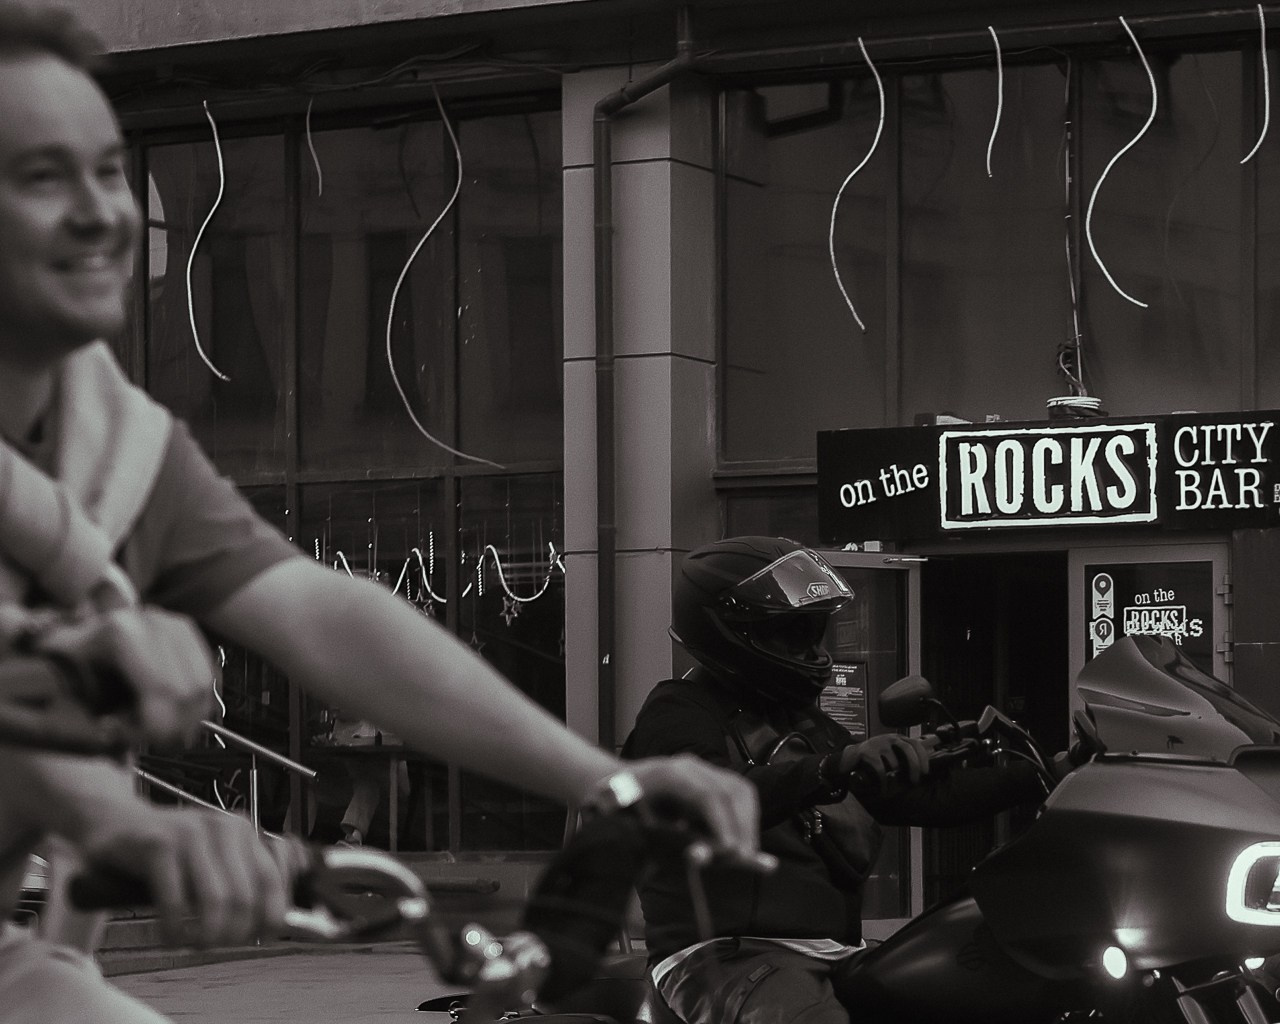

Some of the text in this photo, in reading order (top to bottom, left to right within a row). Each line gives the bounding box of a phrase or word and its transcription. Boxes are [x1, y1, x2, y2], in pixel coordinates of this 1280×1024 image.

[1174, 422, 1274, 467] CITY
[840, 434, 1137, 516] on the ROCKS
[1175, 467, 1264, 510] BAR
[1134, 588, 1175, 605] on the
[1098, 623, 1107, 636] Я
[1131, 610, 1178, 630] ROCKS
